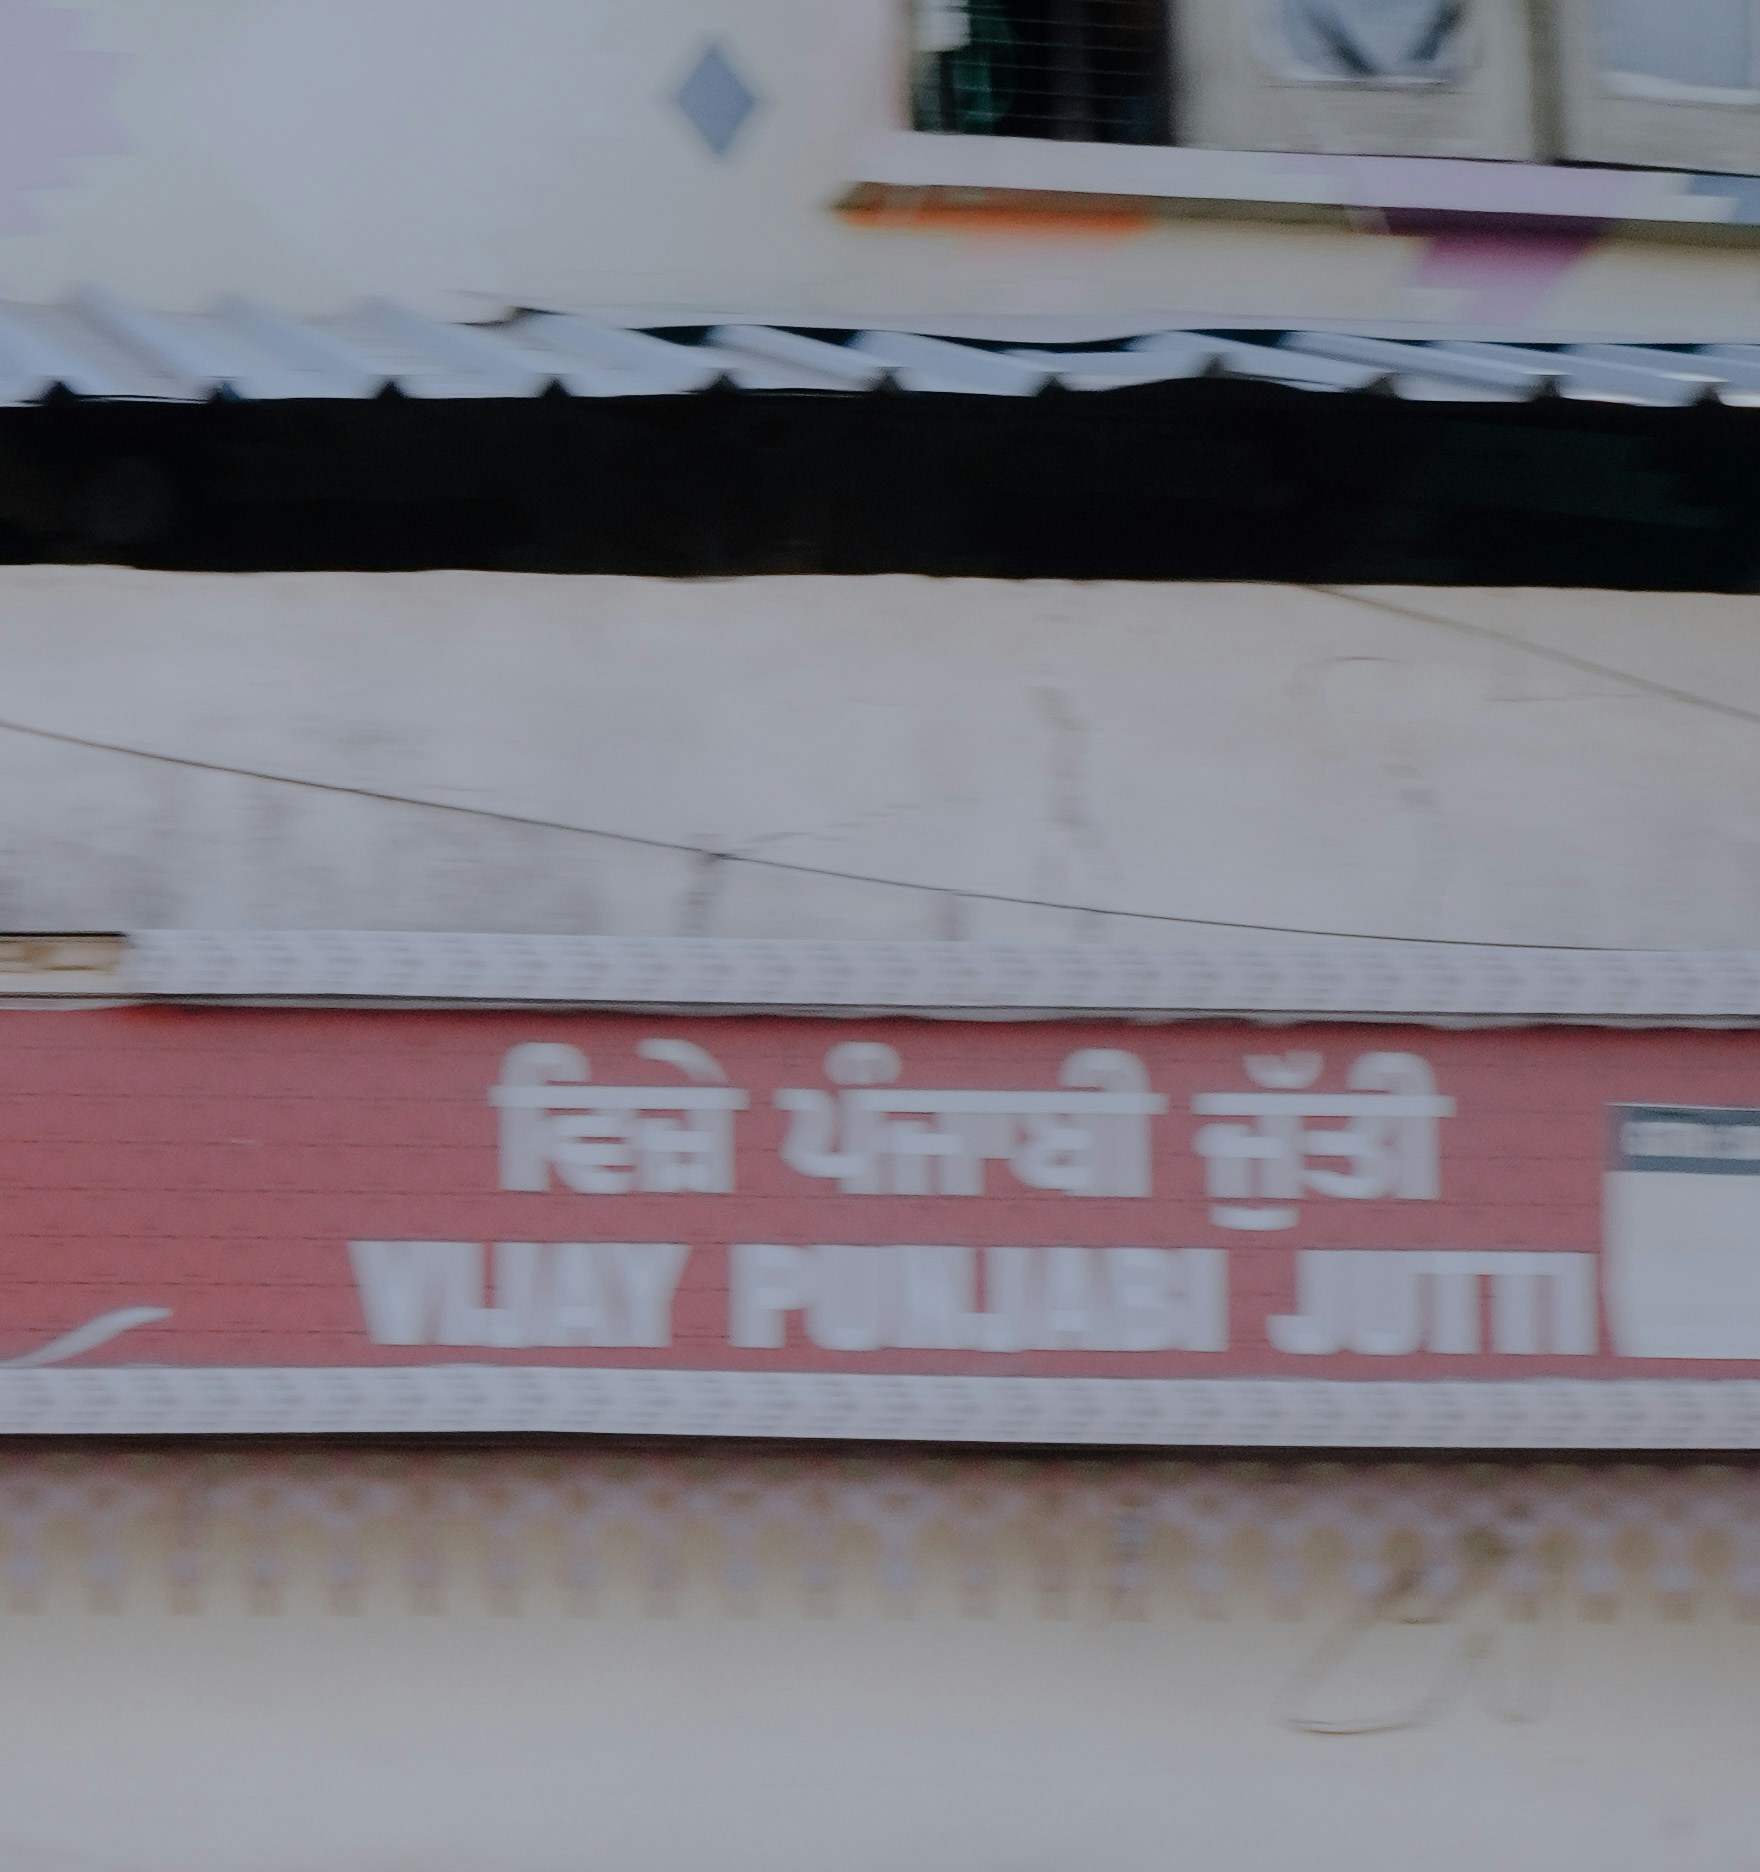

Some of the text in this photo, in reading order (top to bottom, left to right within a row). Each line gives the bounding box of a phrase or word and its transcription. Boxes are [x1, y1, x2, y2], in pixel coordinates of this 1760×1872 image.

[772, 1040, 1168, 1198] ਪੰਜਾਬੀ
[1190, 1049, 1457, 1231] ਜੁੱਤੀ
[350, 1239, 1597, 1357] VIJAY PUNJABI JUTTI
